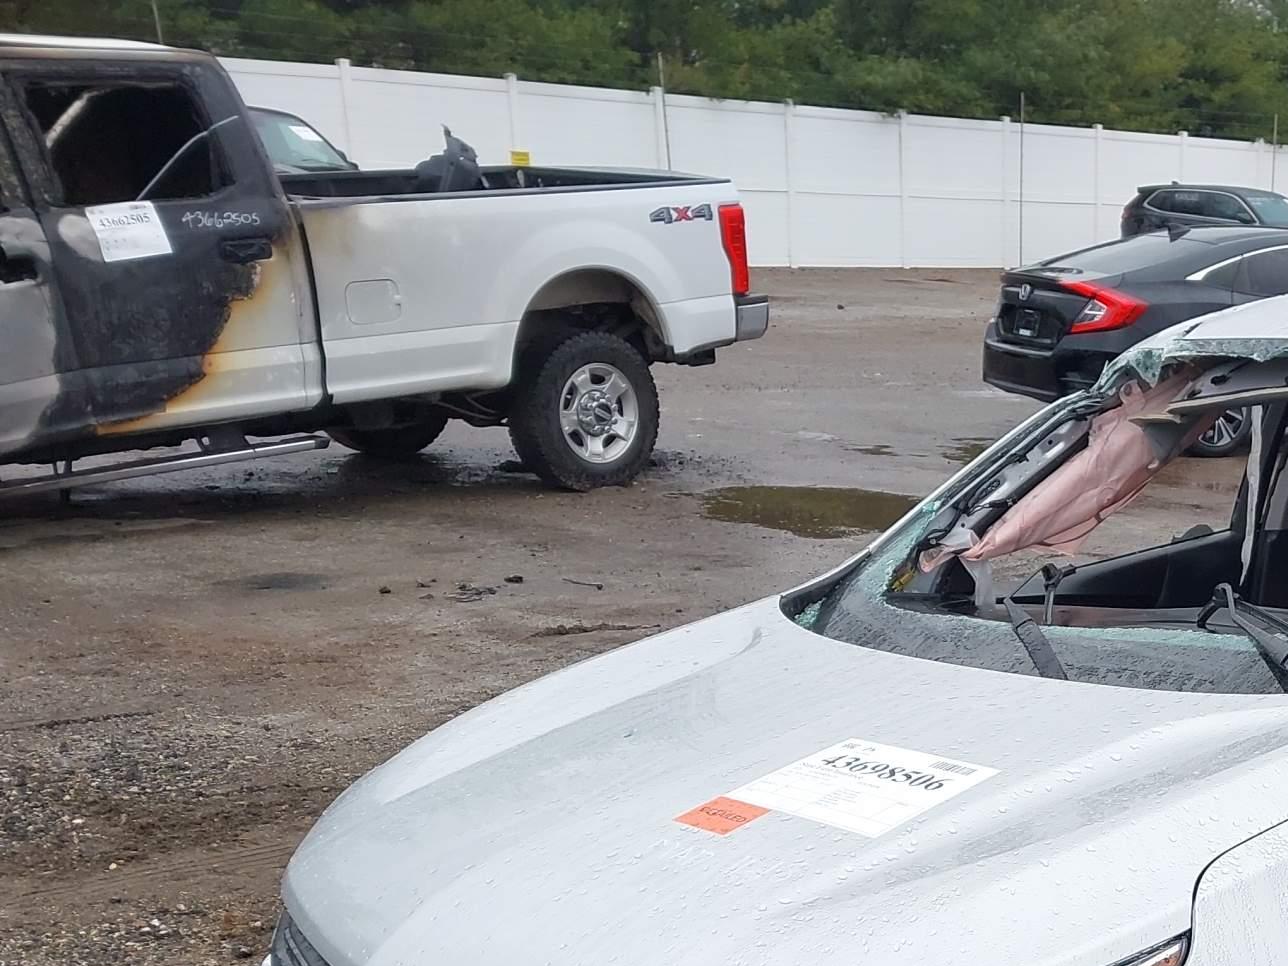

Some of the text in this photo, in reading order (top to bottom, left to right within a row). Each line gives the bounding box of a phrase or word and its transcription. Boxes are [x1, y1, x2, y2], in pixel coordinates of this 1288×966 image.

[99, 212, 151, 228] 43662505
[181, 212, 260, 228] 43662505
[821, 754, 951, 792] 43698506
